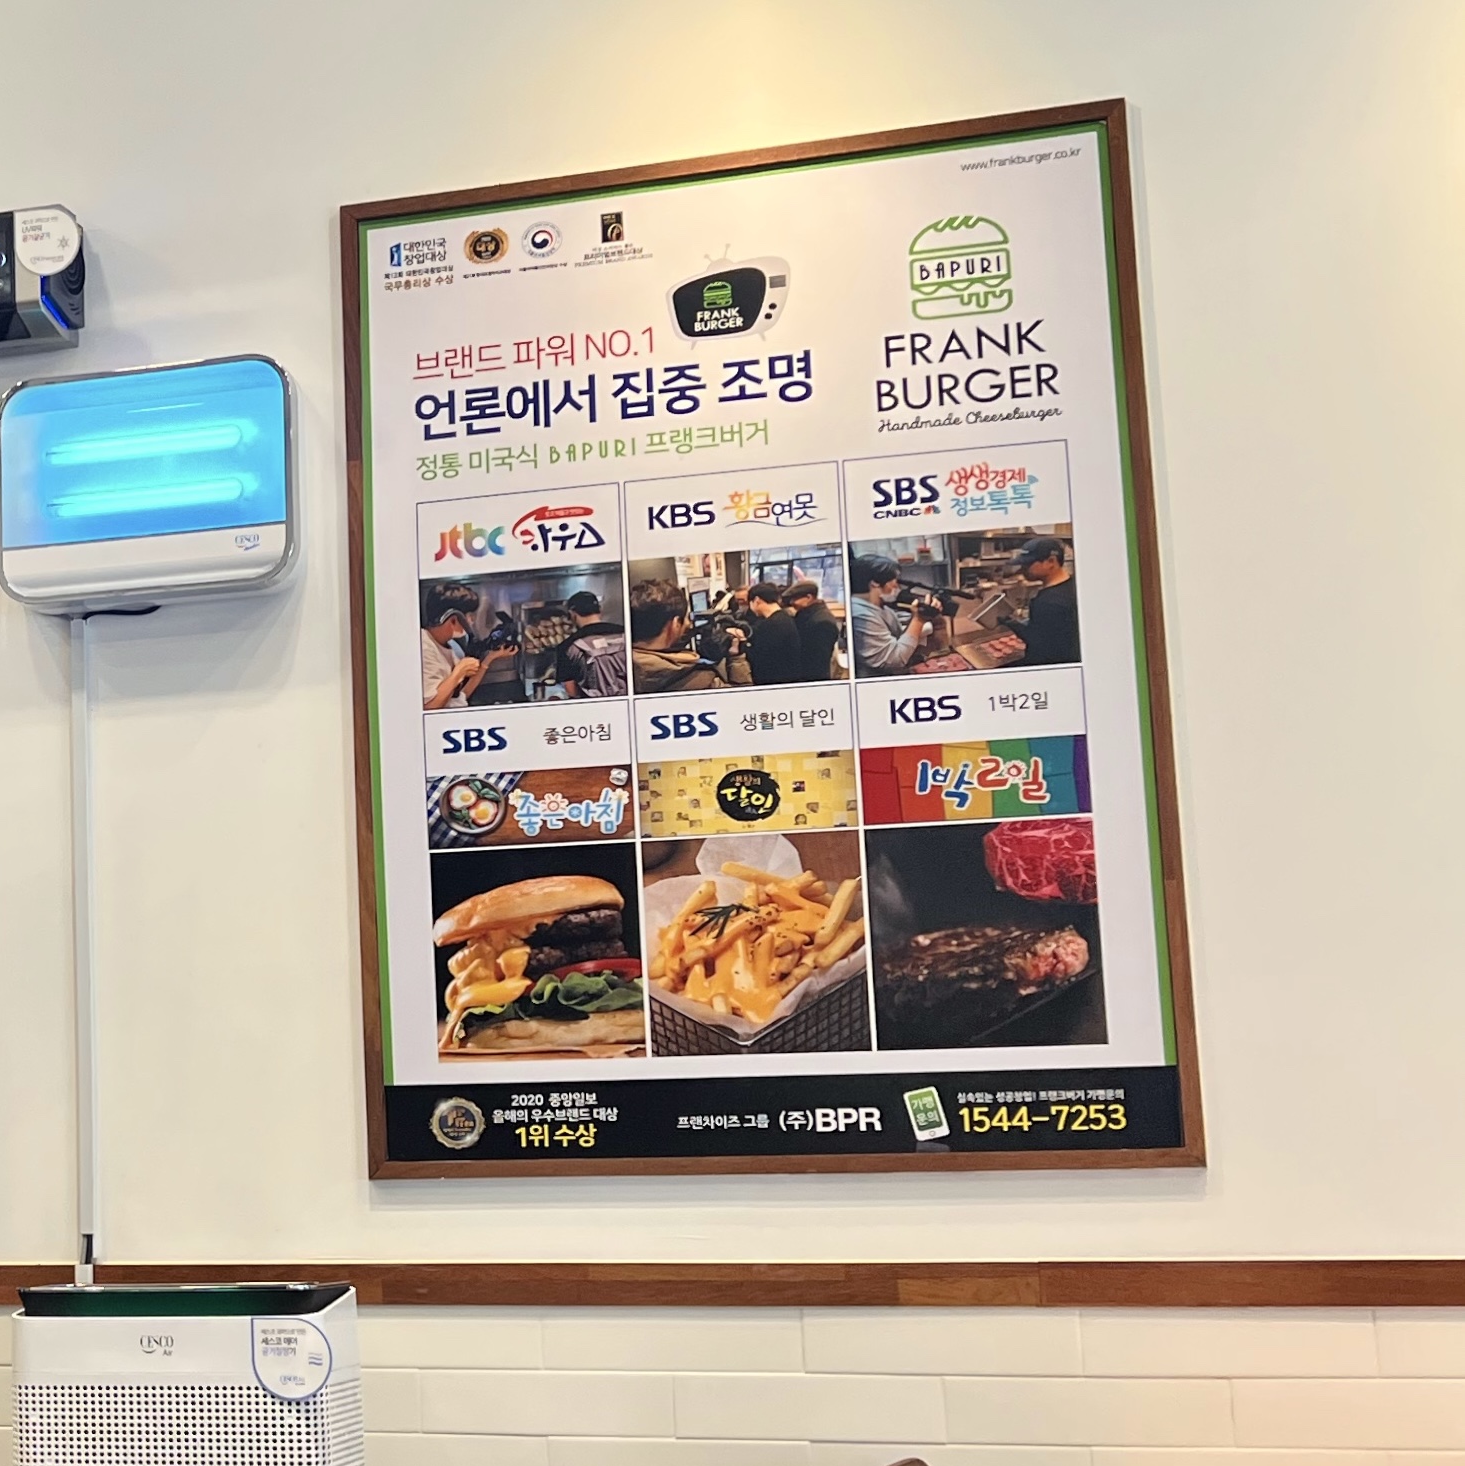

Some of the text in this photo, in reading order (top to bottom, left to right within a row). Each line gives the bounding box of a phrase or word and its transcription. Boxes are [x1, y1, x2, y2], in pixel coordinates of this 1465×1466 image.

[960, 148, 1081, 171] www.frankburger.co.kr
[404, 250, 447, 266] 창업대상
[919, 255, 1002, 281] BAPURI
[384, 274, 453, 292] 국무총리상 수상
[694, 317, 744, 332] BURGER
[696, 307, 740, 322] FRANK
[413, 326, 655, 380] 브랜드 파워 NO.1
[884, 319, 1046, 368] FRANK
[415, 349, 813, 441] 언론에서 집중 조명
[876, 363, 1060, 412] BURGER
[878, 415, 963, 433] Handmade
[416, 420, 769, 481] 정통 미국식 BAPURI 프랭크버거
[872, 475, 940, 508] SBS
[945, 462, 1026, 496] 생생경제
[648, 489, 818, 530] KBS 황금연못
[873, 508, 922, 519] CNBC
[950, 483, 1035, 517] 정보톡톡
[434, 522, 506, 562] jtbc
[890, 691, 1049, 724] KBS 1박2일
[650, 708, 835, 740] SBS 생활의 달인
[442, 723, 611, 754] SBS 좋은아침
[916, 756, 1050, 811] 1박2일
[516, 789, 625, 835] 좋은아침
[720, 786, 774, 815] 달인
[511, 1092, 598, 1108] 2020 중앙일보
[911, 1094, 934, 1111] 가맹
[491, 1109, 529, 1124] 올해의
[531, 1108, 592, 1122] 우수브랜드
[593, 1107, 618, 1122] 대상
[676, 1115, 741, 1129] 프랜차이즈
[743, 1113, 770, 1129] 그룹
[915, 1110, 940, 1127] 문의
[958, 1104, 1127, 1132] 1544-7253
[515, 1123, 598, 1148] 1위 수상
[140, 1335, 174, 1351] CESCO
